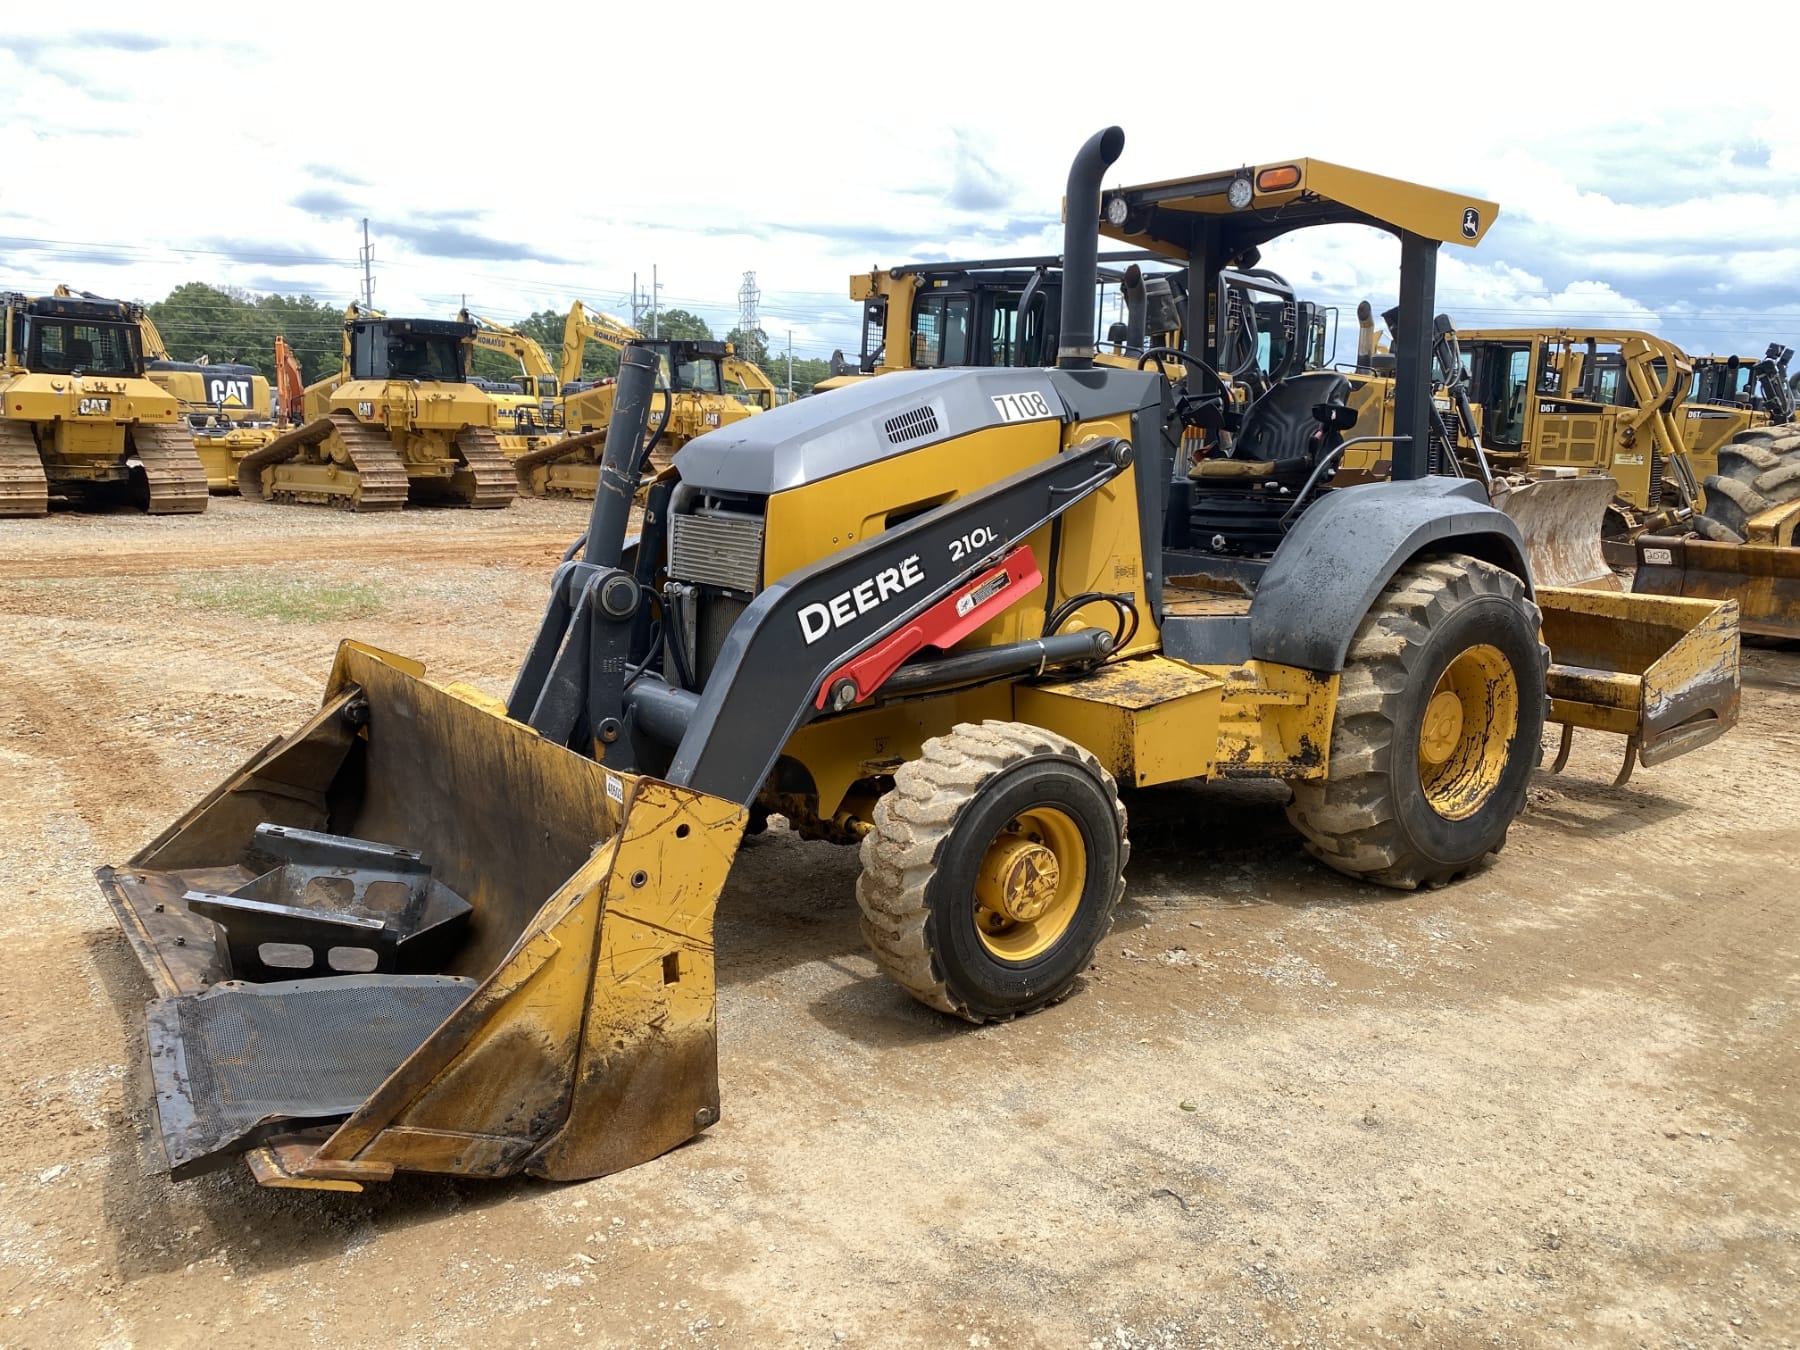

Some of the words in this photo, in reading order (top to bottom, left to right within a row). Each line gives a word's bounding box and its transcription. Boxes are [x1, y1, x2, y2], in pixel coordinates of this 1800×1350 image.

[477, 335, 506, 348] KOMATSU
[211, 379, 249, 406] CAT
[80, 398, 108, 414] CAT
[358, 402, 372, 416] CAT
[993, 393, 1049, 420] 7108
[1540, 404, 1556, 412] D6T
[705, 413, 719, 425] CAT
[948, 526, 999, 562] 210L
[797, 554, 925, 645] DEERE
